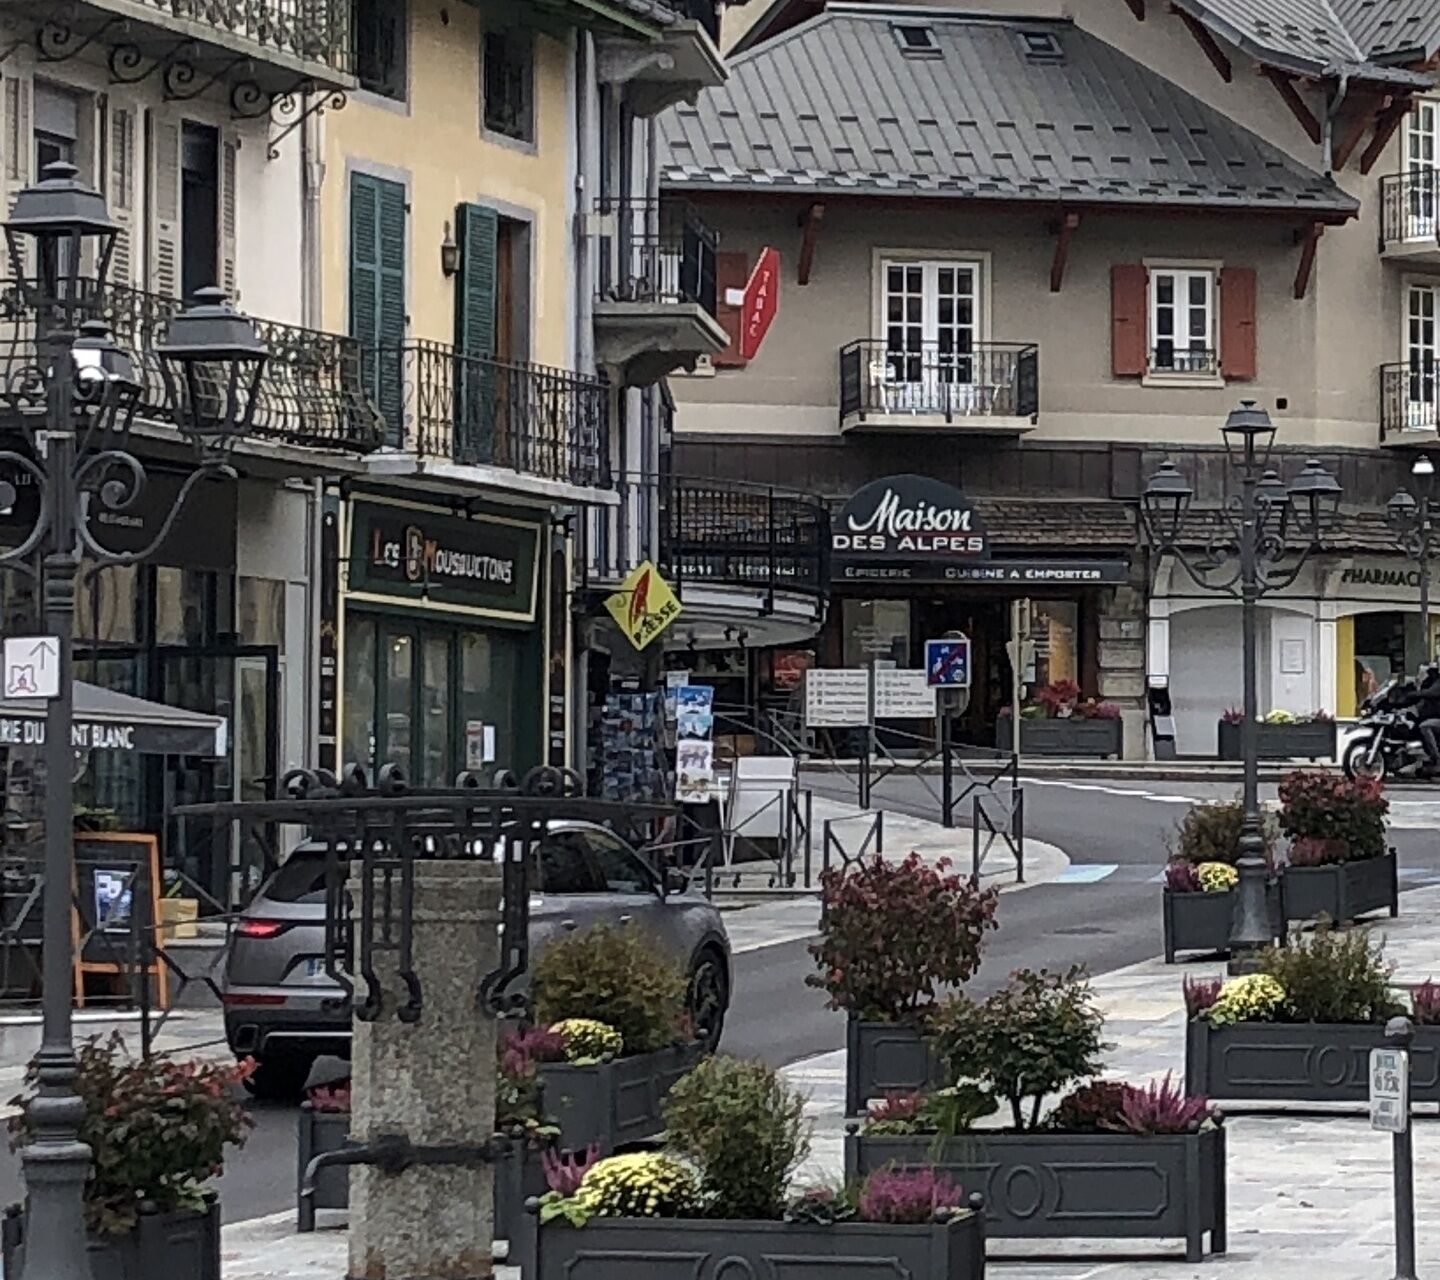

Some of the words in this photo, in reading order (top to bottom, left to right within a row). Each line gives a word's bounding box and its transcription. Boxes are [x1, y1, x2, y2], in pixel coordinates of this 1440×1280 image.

[749, 271, 774, 337] TABAC
[849, 488, 972, 538] Maison
[832, 535, 886, 550] DES
[898, 536, 984, 552] ALPES
[945, 567, 1004, 579] CUISINE
[1025, 569, 1101, 579] EMPORTER
[24, 720, 45, 745] DU
[92, 725, 135, 750] BLANC
